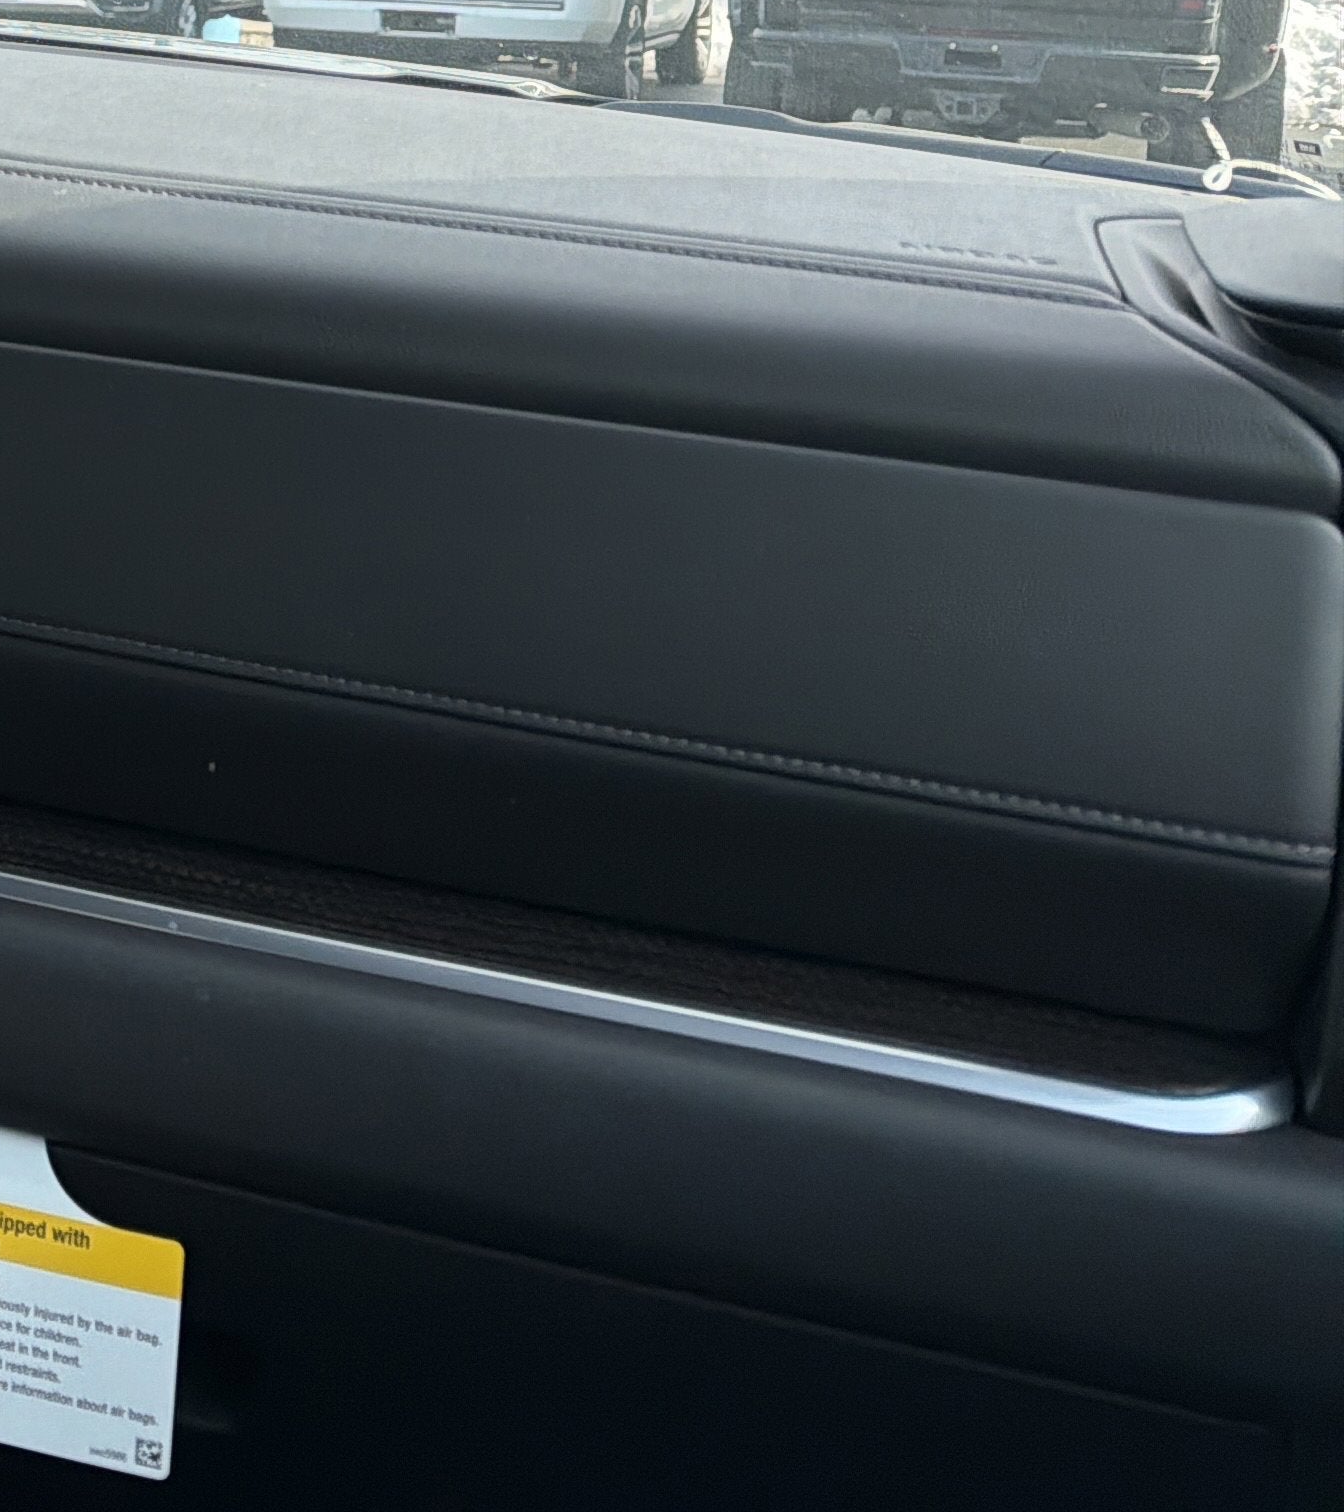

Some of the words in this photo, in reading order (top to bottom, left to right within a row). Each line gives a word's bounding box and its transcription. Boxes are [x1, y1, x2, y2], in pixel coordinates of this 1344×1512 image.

[52, 1226, 91, 1250] with
[15, 1321, 31, 1336] for
[33, 1326, 82, 1348] children.
[33, 1304, 74, 1326] injured
[77, 1315, 92, 1332] by
[95, 1320, 113, 1335] the
[117, 1326, 132, 1339] air
[137, 1329, 162, 1348] bag.
[18, 1343, 29, 1355] in
[31, 1345, 49, 1360] the
[52, 1349, 82, 1368] front.
[5, 1360, 62, 1384] restraints.
[11, 1379, 73, 1407] information
[76, 1398, 108, 1415] about
[110, 1405, 126, 1418] air
[128, 1408, 159, 1427] bags.
